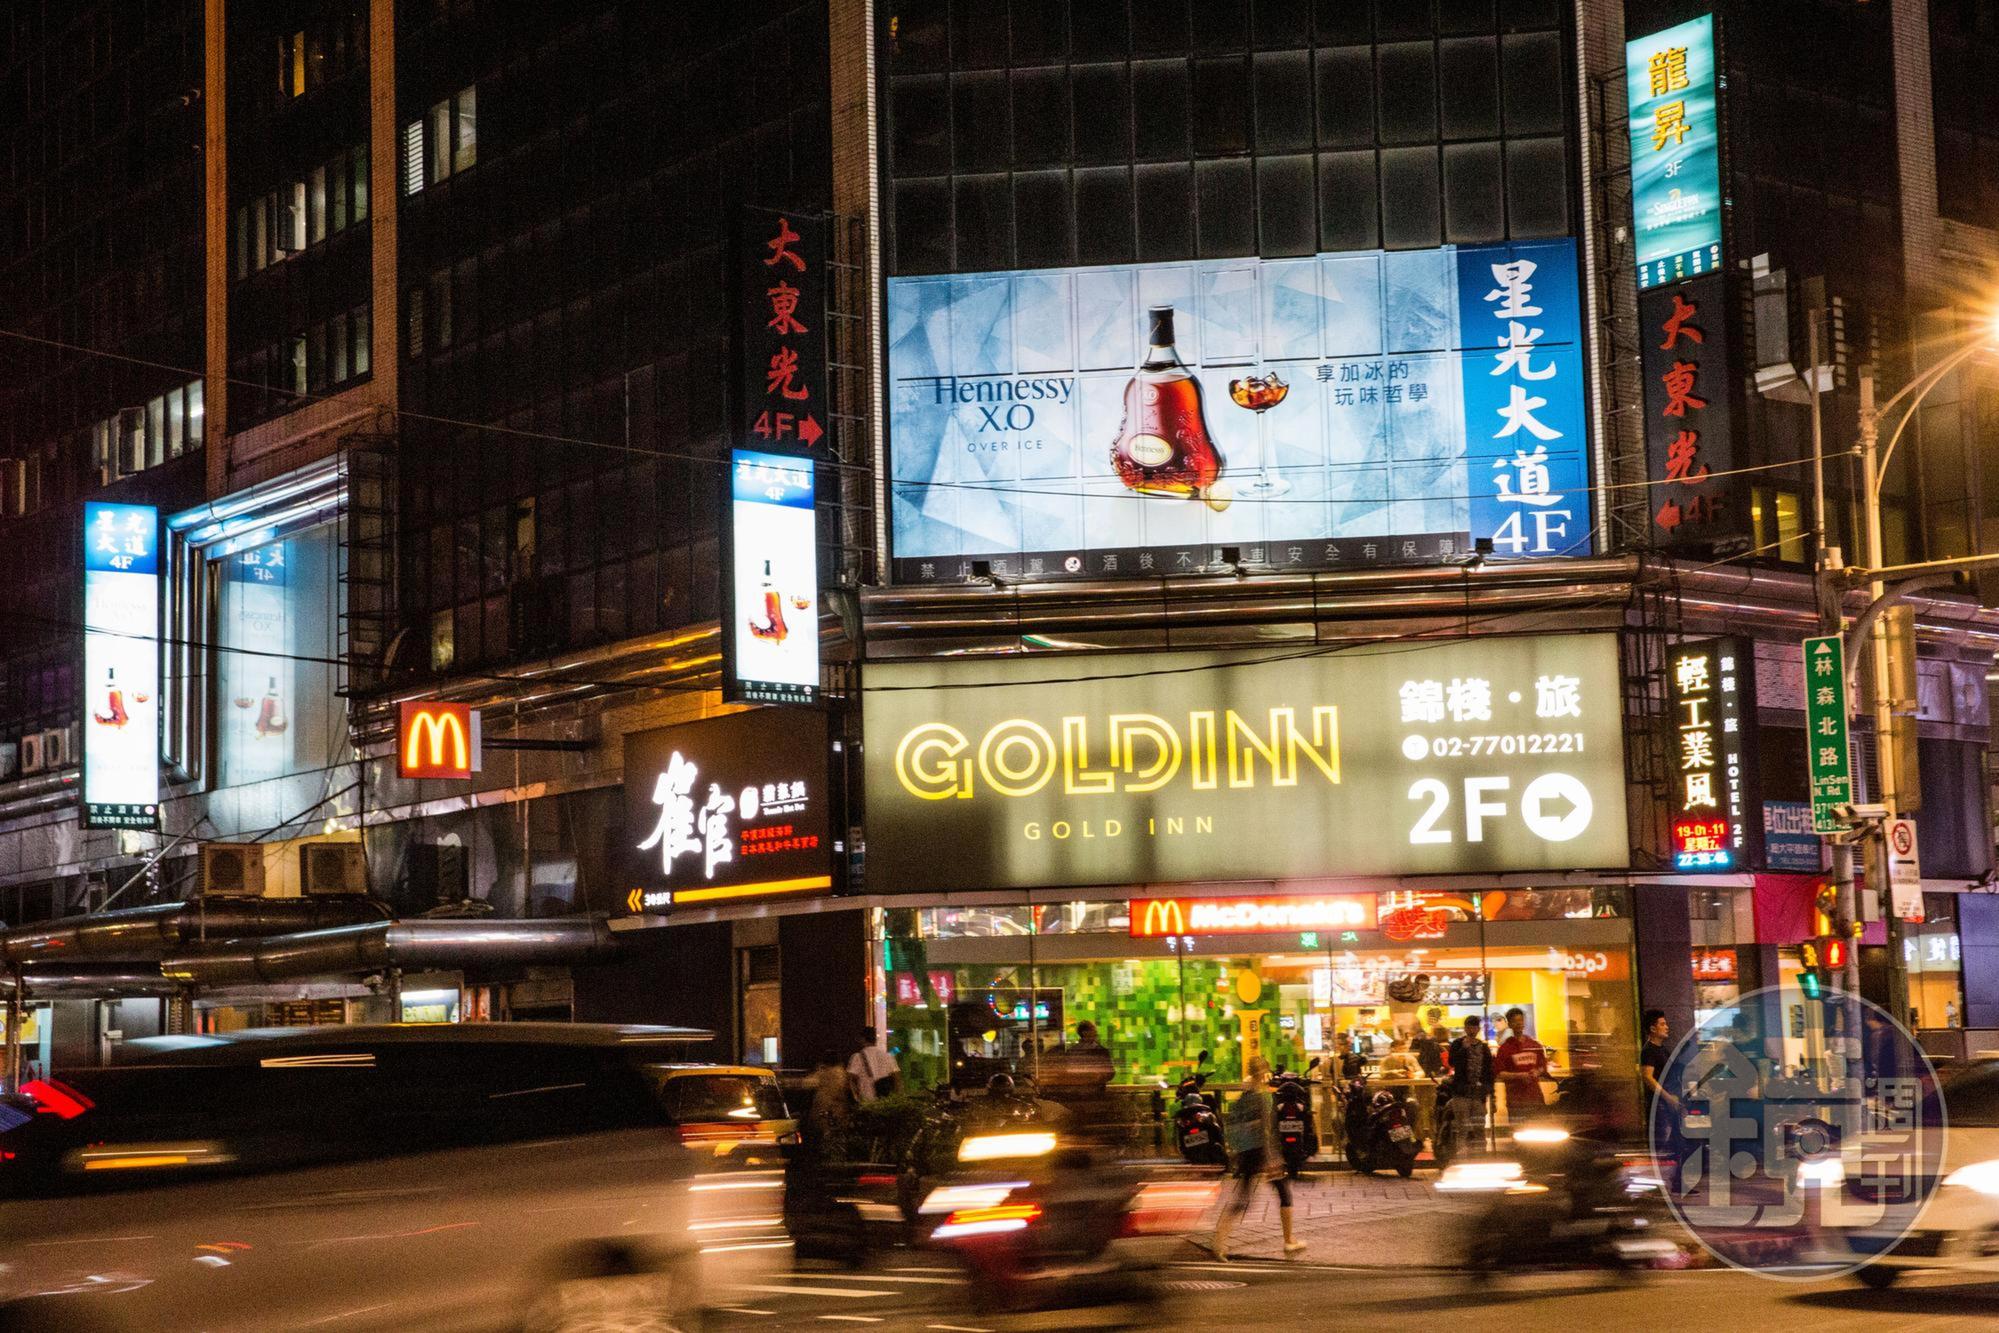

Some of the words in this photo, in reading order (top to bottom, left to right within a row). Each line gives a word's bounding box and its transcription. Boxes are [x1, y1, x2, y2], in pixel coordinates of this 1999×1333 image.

[1647, 46, 1692, 151] 龍昇
[1664, 159, 1683, 178] 3F
[764, 218, 809, 400] 大東光
[1316, 360, 1409, 383] 享加冰的
[1483, 258, 1568, 507] 星光大道
[935, 376, 1075, 405] Hennessy
[1334, 383, 1428, 406] 玩味哲學
[1660, 295, 1707, 486] 大東光
[753, 412, 795, 440] 4F
[967, 441, 1009, 453] OVER
[1018, 439, 1044, 451] ICE
[1491, 510, 1572, 554] 4F
[109, 555, 134, 570] 4F
[1814, 657, 1839, 767] 林森北路
[1432, 733, 1584, 757] 02-77012221
[1676, 655, 1717, 811] 輕工業風
[1728, 753, 1741, 816] HOTEL
[1407, 776, 1510, 844] 2F
[1023, 818, 1123, 842] GOLD
[1148, 816, 1214, 836] INN
[1733, 823, 1743, 848] 2F
[1190, 899, 1365, 930] McDonald's
